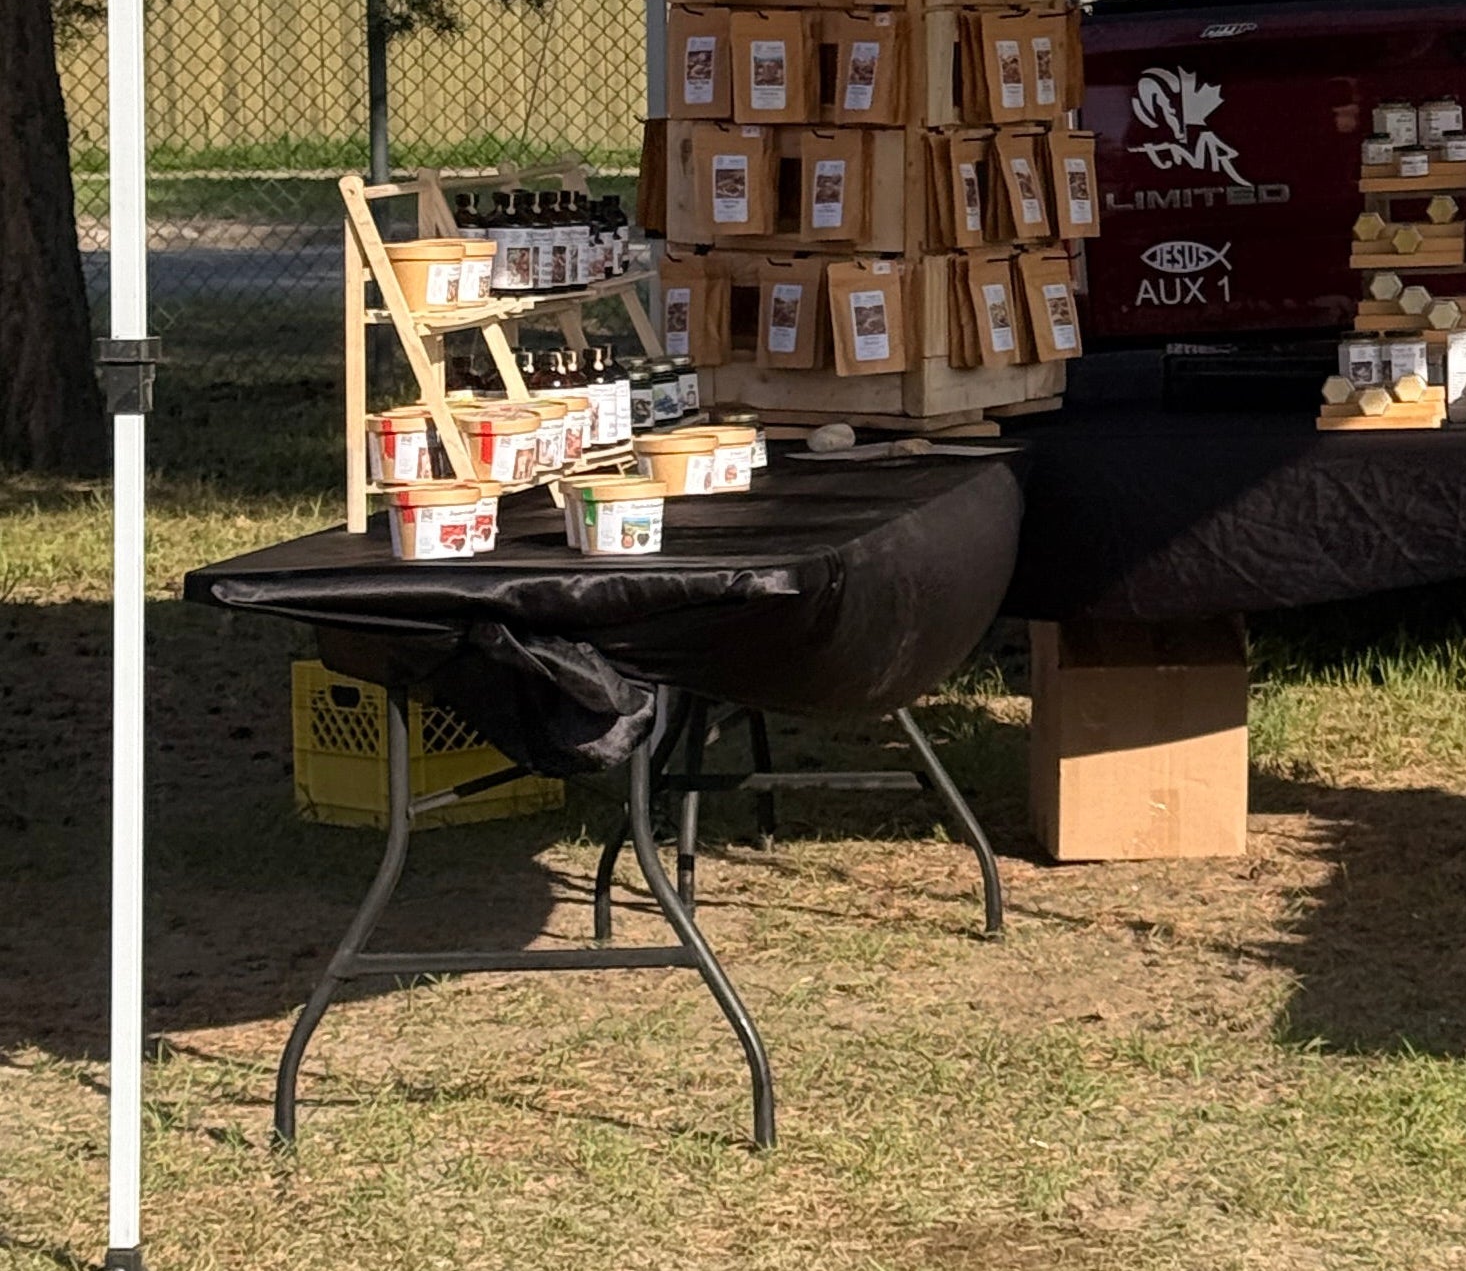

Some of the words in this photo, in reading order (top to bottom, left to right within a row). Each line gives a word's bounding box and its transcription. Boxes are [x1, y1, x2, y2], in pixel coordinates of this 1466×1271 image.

[1105, 183, 1291, 211] LIMITED
[1155, 243, 1209, 270] JESUS
[1135, 277, 1208, 307] AUX
[1216, 276, 1230, 303] 1
